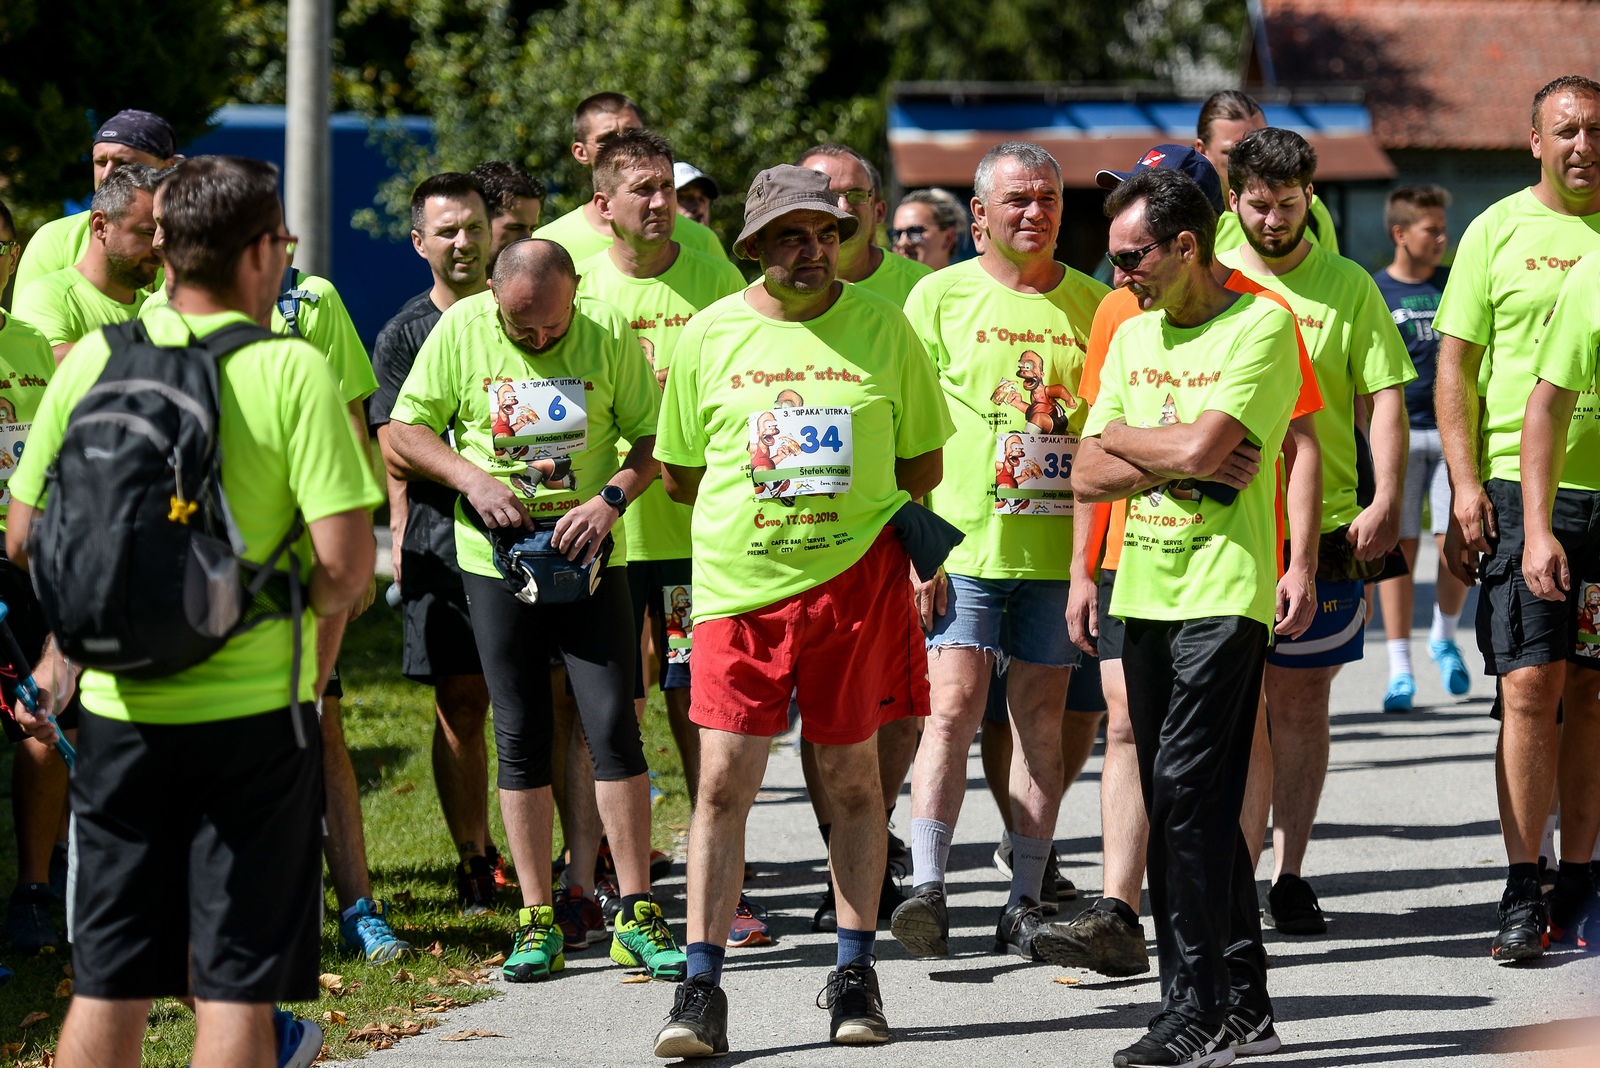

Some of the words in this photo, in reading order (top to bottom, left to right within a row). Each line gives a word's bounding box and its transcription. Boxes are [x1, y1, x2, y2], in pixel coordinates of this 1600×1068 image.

[1525, 257, 1541, 271] 3.
[976, 329, 990, 343] 3.
[990, 326, 1052, 346] "Opaka"
[530, 380, 558, 388] "OPAKA"
[560, 378, 582, 386] UTRKA
[731, 374, 745, 389] 3.
[746, 364, 815, 387] "Opaka"
[815, 366, 862, 383] utrka
[1129, 370, 1140, 386] 3.
[548, 395, 567, 421] 6
[792, 408, 823, 416] "OPAKA"
[536, 434, 561, 442] Mladen
[563, 432, 583, 440] Koren
[800, 425, 843, 454] 34
[1038, 436, 1063, 444] "OPAKA"
[800, 466, 824, 476] Štefek
[826, 466, 849, 475] Vincek
[1043, 453, 1072, 479] 35
[1042, 491, 1057, 499] Josip
[754, 507, 783, 528] Čevo,
[1323, 600, 1337, 613] HT
